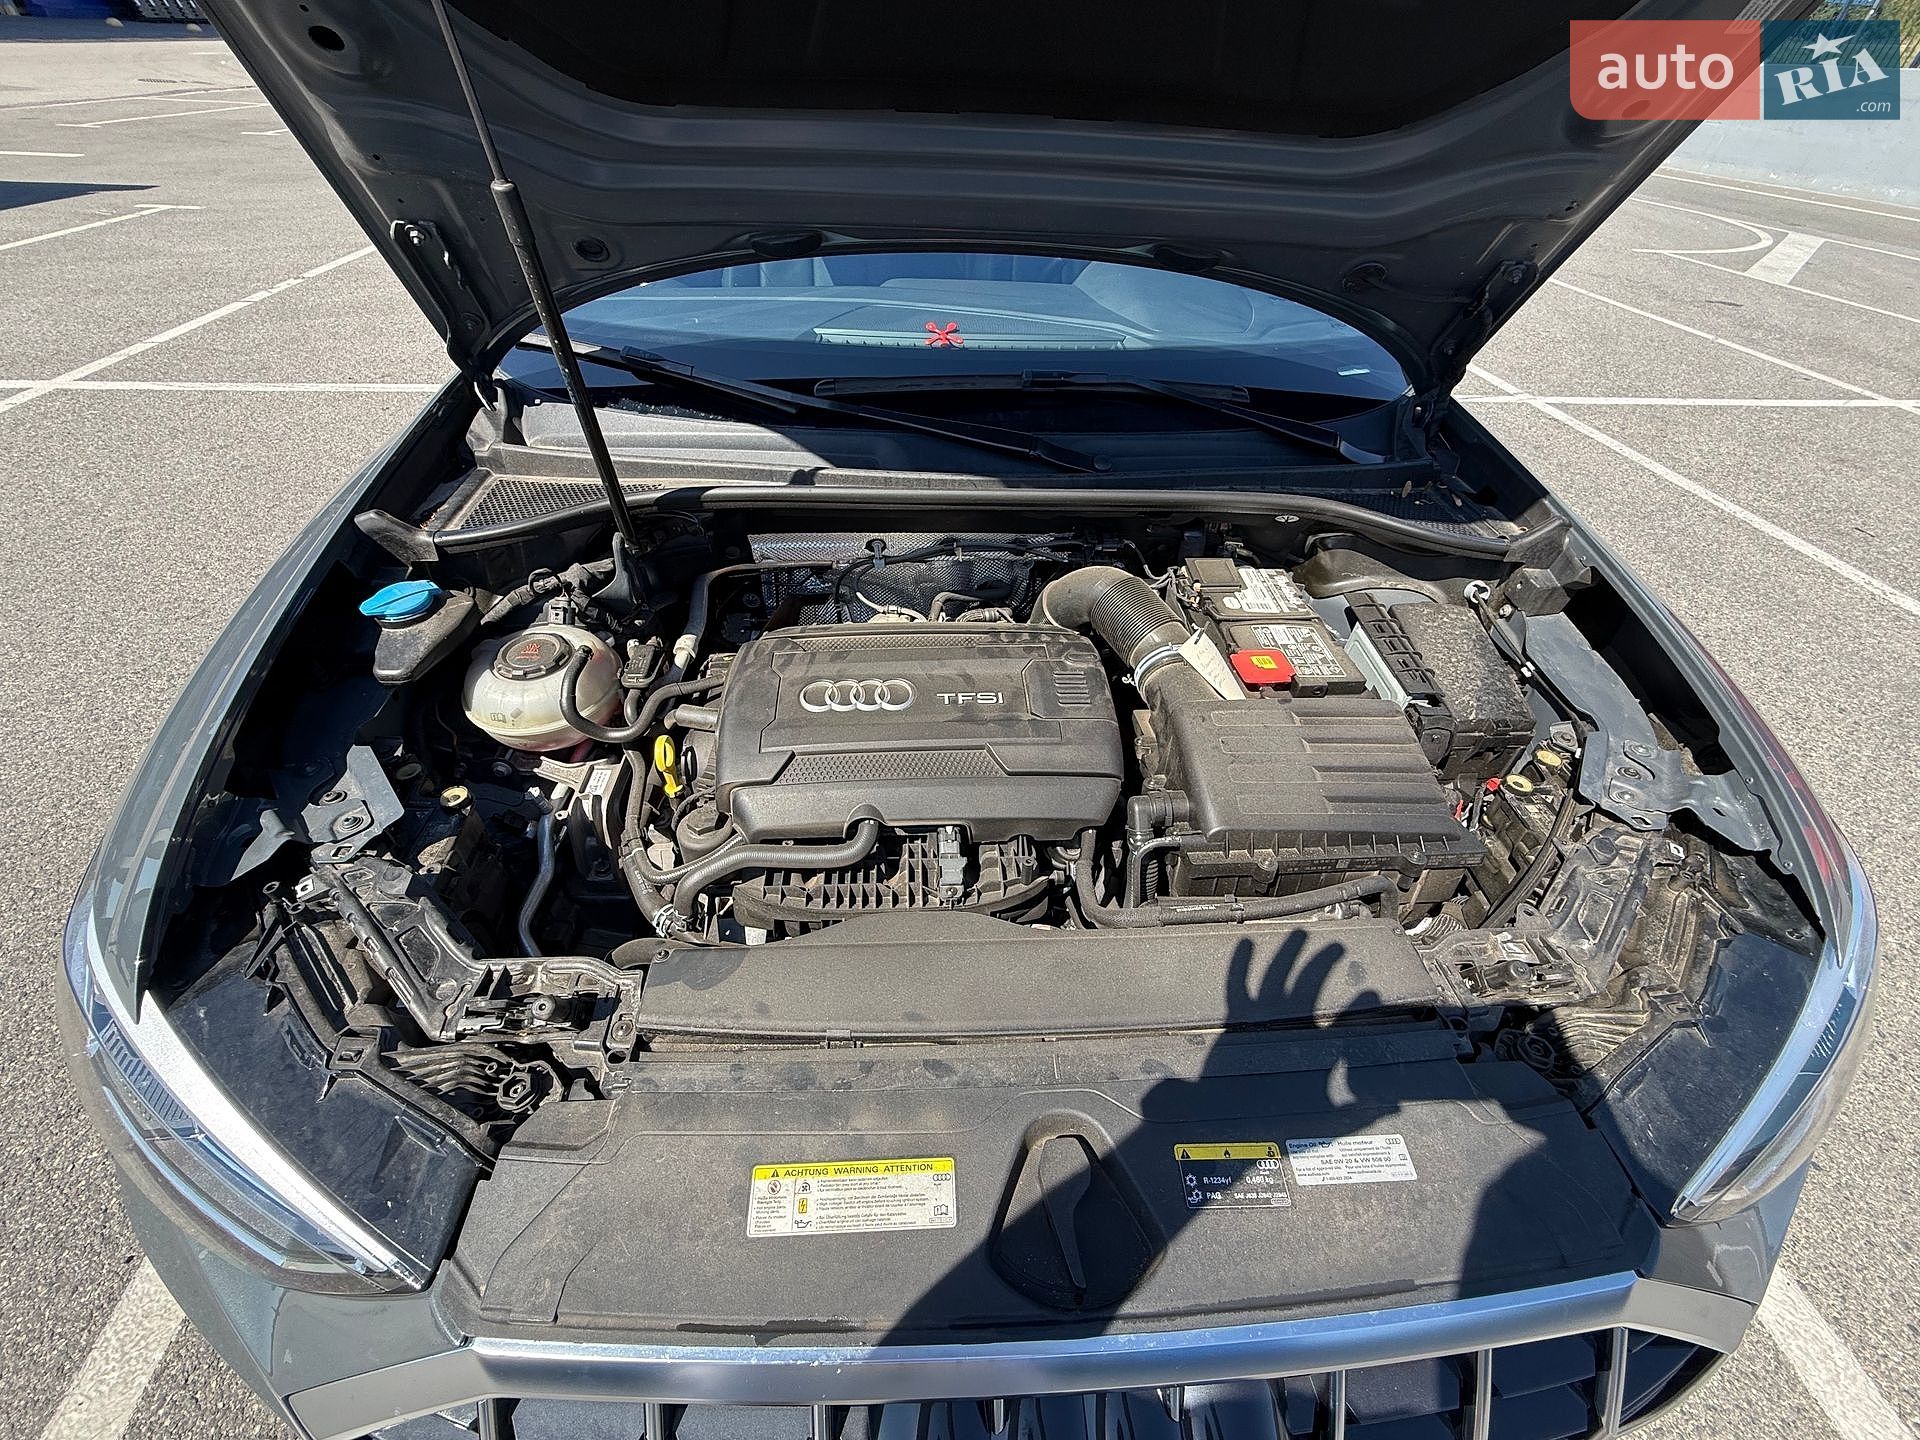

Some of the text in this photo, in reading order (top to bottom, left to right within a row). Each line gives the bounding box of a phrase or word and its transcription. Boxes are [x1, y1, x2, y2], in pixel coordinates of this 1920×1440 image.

[936, 692, 1004, 704] TFSI
[784, 1163, 933, 1177] ACHTUNG WARNING ATTENTION
[1206, 1191, 1222, 1200] PAG
